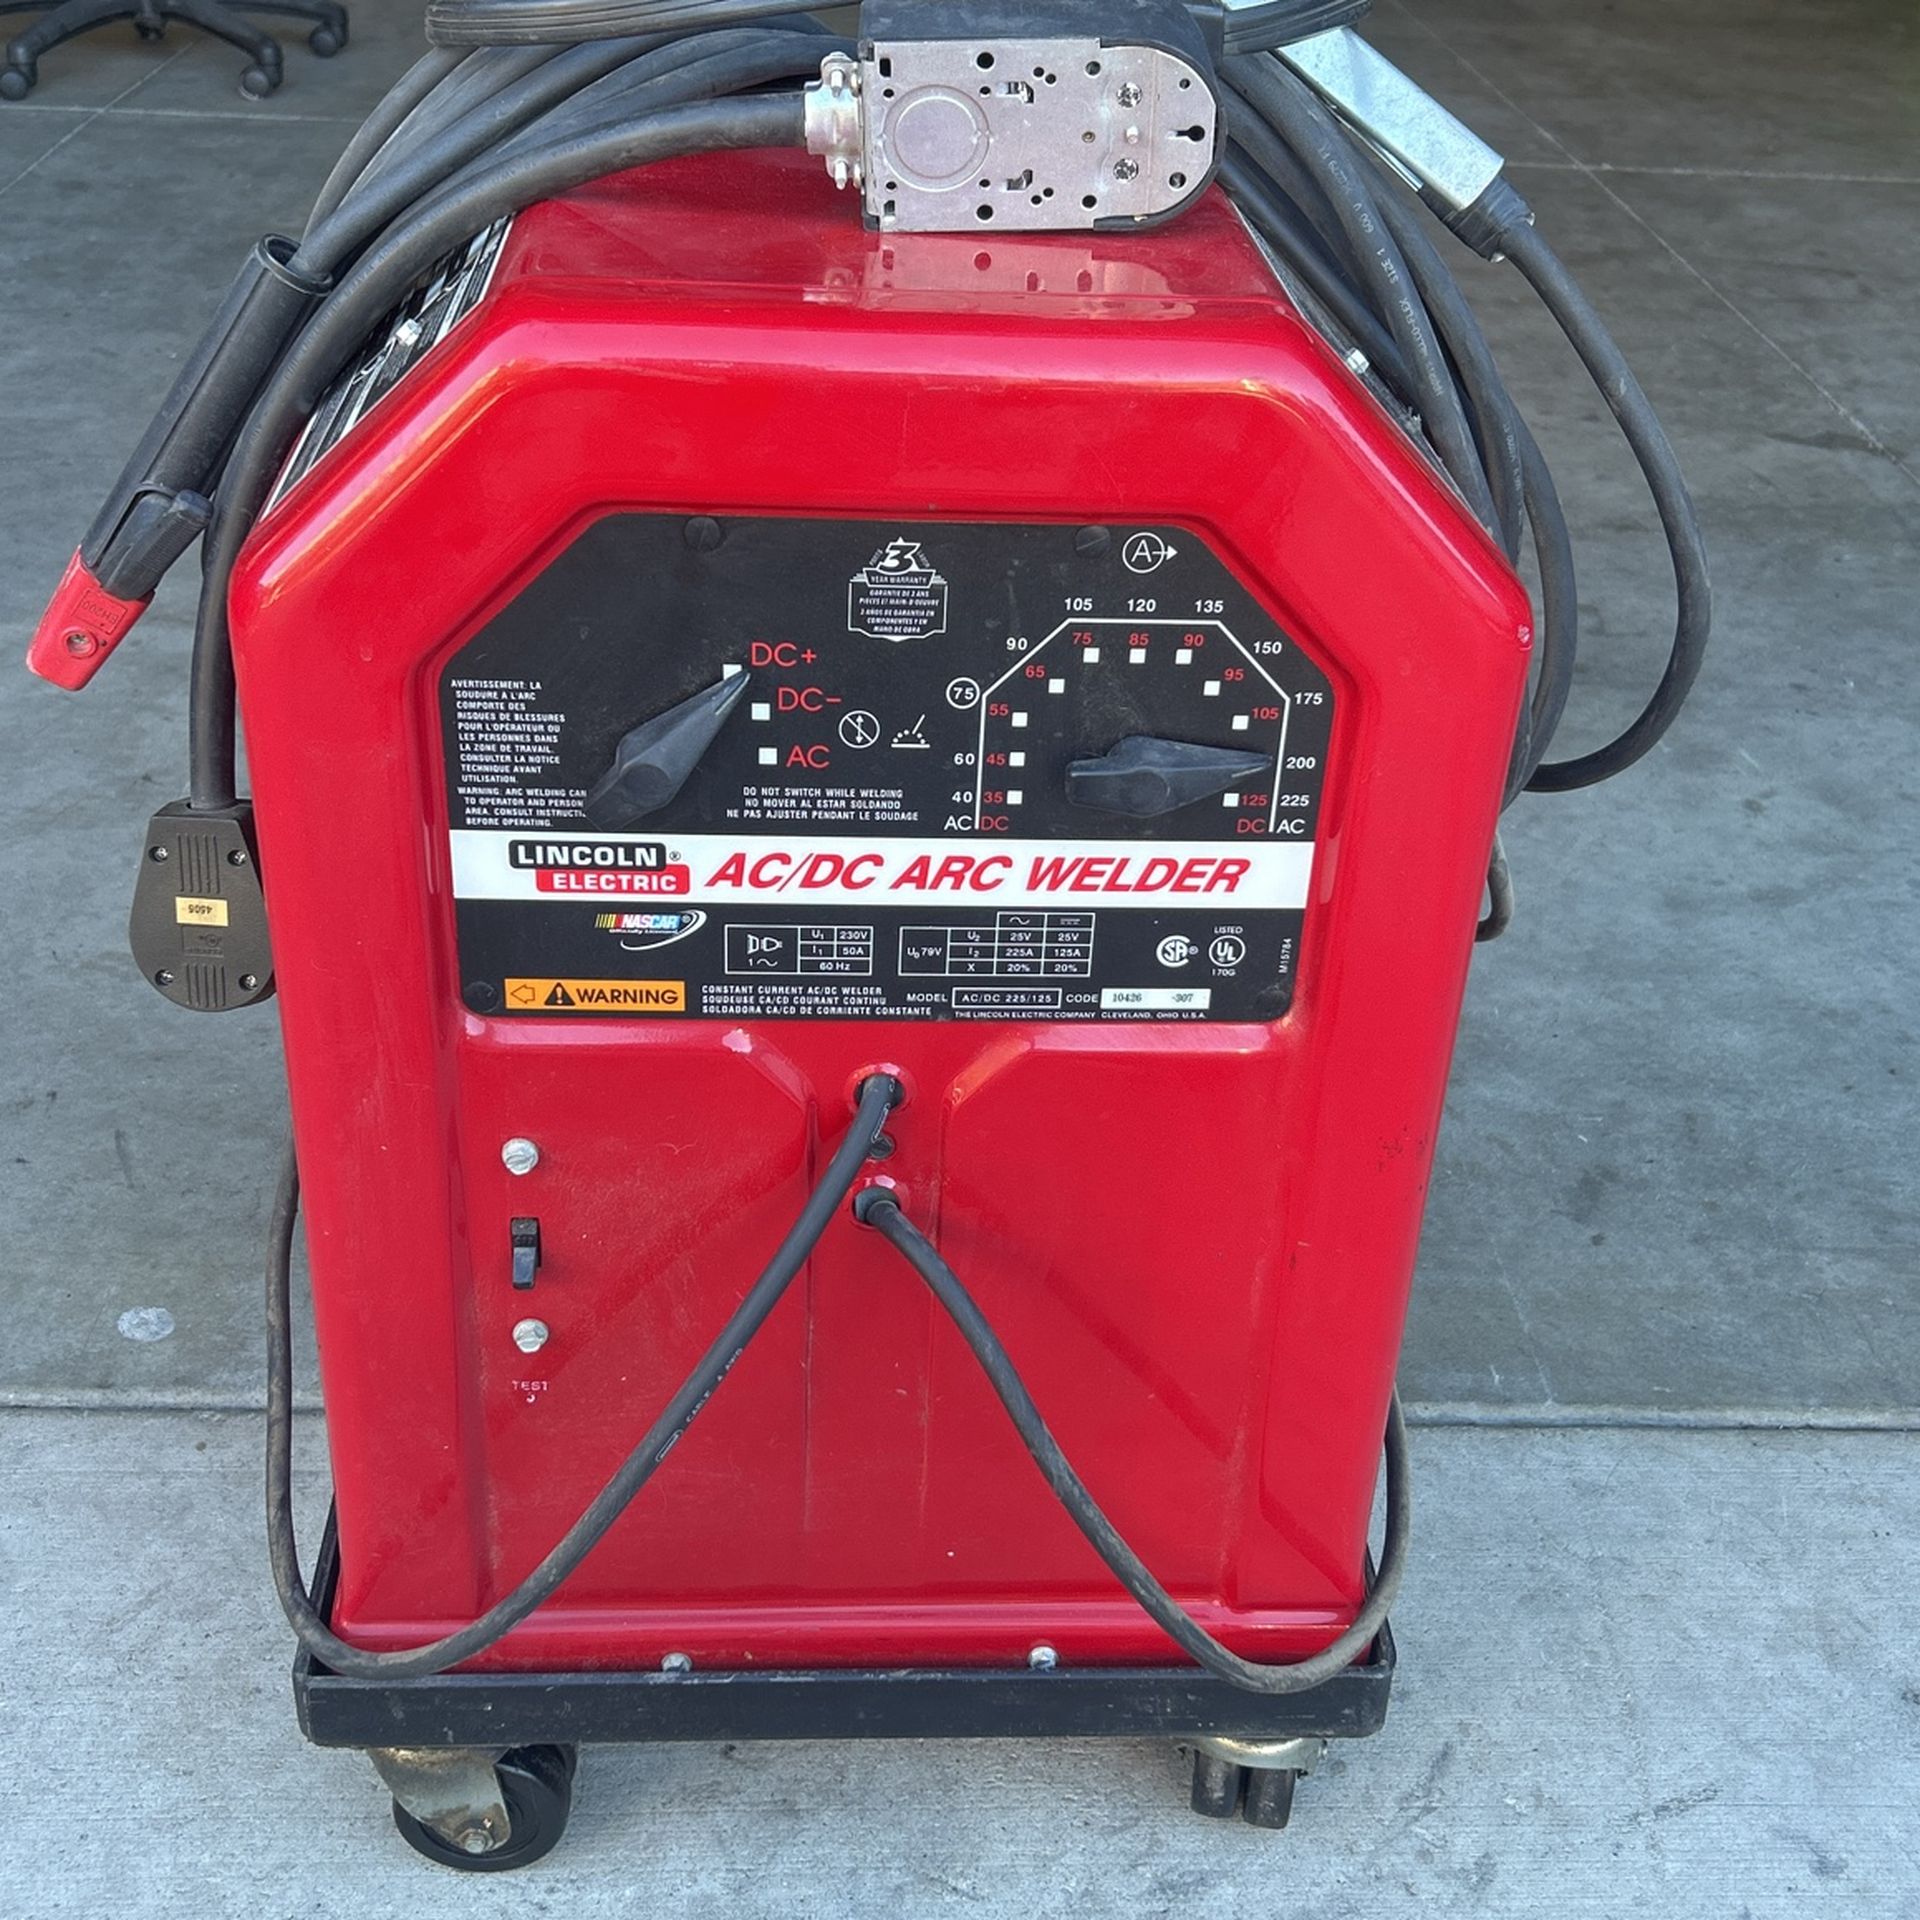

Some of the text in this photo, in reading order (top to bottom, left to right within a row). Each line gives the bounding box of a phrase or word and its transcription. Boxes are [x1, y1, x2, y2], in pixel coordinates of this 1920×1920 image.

[1359, 213, 1375, 234] 600
[1380, 258, 1399, 284] SIZE
[1065, 598, 1092, 611] 105
[1128, 598, 1156, 612] 120
[1195, 600, 1223, 613] 135
[1006, 637, 1028, 650] 90
[1073, 632, 1092, 645] 75
[1129, 633, 1149, 646] 85
[1184, 634, 1204, 647] 90
[1254, 641, 1282, 654] 150
[751, 642, 816, 667] DC+
[1025, 665, 1045, 678] 65
[1225, 668, 1244, 680] 95
[530, 682, 542, 690] LA
[456, 690, 499, 699] SOUDURE
[953, 687, 974, 700] 75
[1295, 692, 1323, 705] 175
[456, 701, 526, 711] COMPORTE DES
[990, 704, 1008, 716] 55
[457, 712, 566, 722] RISQUES DE BLESSURES
[1253, 707, 1279, 720] 105
[458, 722, 483, 731] POUR
[547, 724, 561, 733] OU
[459, 733, 558, 743] LES PERSONNES DANS
[459, 743, 471, 751] LA
[474, 743, 497, 752] ZONE
[500, 744, 512, 753] DE
[460, 754, 560, 764] CONSULTER LA NOTICE
[786, 745, 829, 768] AC
[954, 753, 975, 765] 60
[986, 754, 1005, 765] 45
[461, 764, 542, 773] TECHNIQUE AVANT
[1286, 757, 1316, 769] 200
[505, 788, 523, 796] ARC
[526, 788, 566, 797] WELDING
[569, 789, 587, 797] CAN
[743, 787, 903, 798] DO NOT SWITCH WHILE WELDING
[952, 791, 973, 803] 40
[984, 792, 1003, 804] 35
[464, 797, 476, 805] TO
[479, 797, 525, 806] OPERATOR
[527, 798, 546, 806] AND
[745, 798, 901, 809] NO MOVER AL ESTAR SOLDANDO
[1243, 794, 1268, 806] 125
[1280, 794, 1310, 807] 225
[494, 808, 533, 816] CONSULT
[727, 809, 918, 821] NE PAS AJUSTER PENDANT LE SOUDAGE
[466, 817, 499, 825] BEFORE
[944, 816, 972, 831] AC
[980, 816, 1008, 831] DC
[1236, 818, 1265, 833] DC
[1276, 818, 1305, 834] AC
[518, 845, 657, 867] LINCOLN
[704, 852, 1251, 893] AC/DC ARC WELDER
[553, 873, 676, 891] ELECTRIC
[622, 914, 678, 929] NASCAR
[839, 931, 868, 940] 230V
[1214, 926, 1243, 934] LISTED
[1010, 932, 1032, 941] 25V
[1058, 932, 1079, 942] 25V
[843, 946, 864, 955] 50A
[921, 947, 942, 956] 79V
[1005, 948, 1034, 956] 225A
[1055, 948, 1081, 957] 125A
[1217, 941, 1236, 961] UL
[819, 962, 850, 970] 60 Hz
[967, 963, 975, 972] X
[1007, 963, 1030, 972] 20%
[1054, 963, 1078, 972] 20%
[702, 985, 882, 995] CONSTANT CURRENT AC/DC WELDER
[576, 988, 678, 1005] WARNING
[702, 995, 886, 1005] SOUDEUSE CA/CD COURANT CONTINU
[906, 993, 948, 1002] MODEL
[962, 994, 1052, 1003] AC/DC 225/125
[1065, 994, 1098, 1003] CODE
[703, 1005, 931, 1015] SOLDADORA CA/CD DE CORRIENTE CONSTANTE
[512, 1380, 548, 1391] TEST
